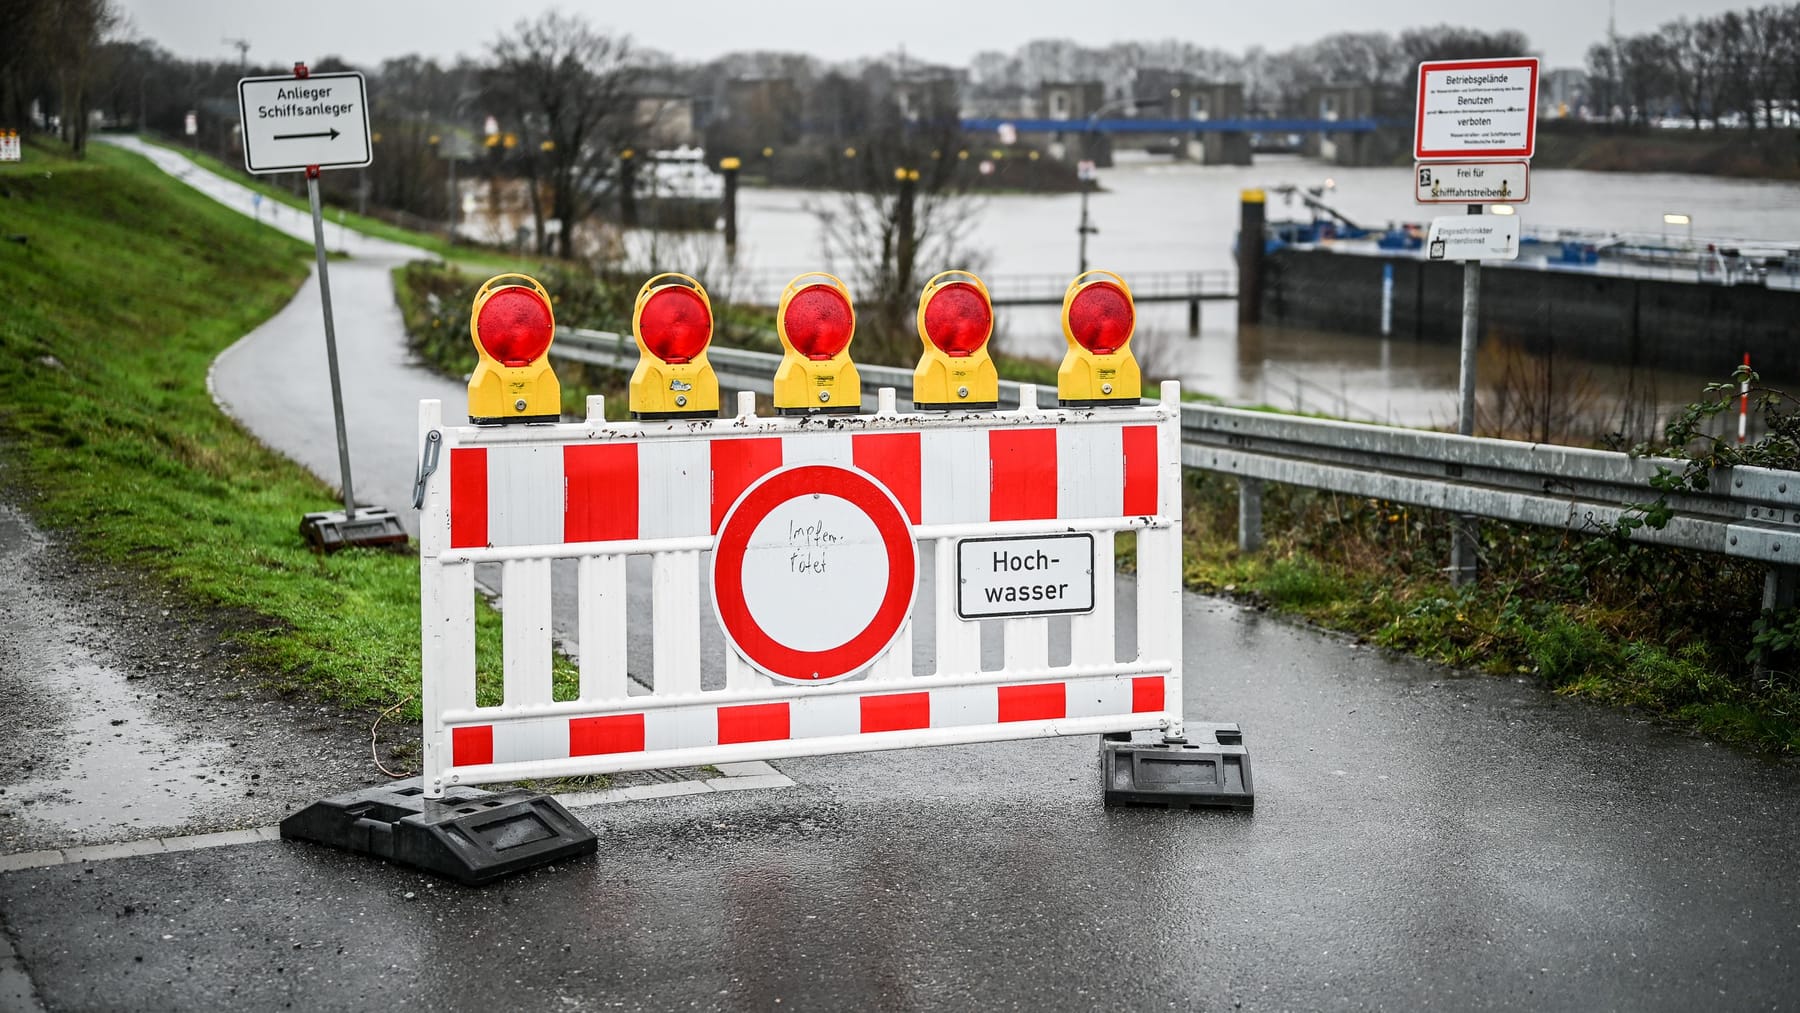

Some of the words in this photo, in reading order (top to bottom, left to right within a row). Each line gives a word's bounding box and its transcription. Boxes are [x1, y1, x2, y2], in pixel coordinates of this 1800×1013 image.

[1446, 74, 1508, 85] Betriebsgelände
[277, 86, 333, 101] Anlieger
[1457, 96, 1493, 105] Benutzen
[258, 102, 354, 118] Schiffsanleger
[1457, 117, 1492, 127] verboten
[1457, 168, 1472, 178] Frei
[1473, 168, 1485, 178] für
[993, 549, 1060, 572] Hoch-
[985, 584, 1069, 603] wasser
